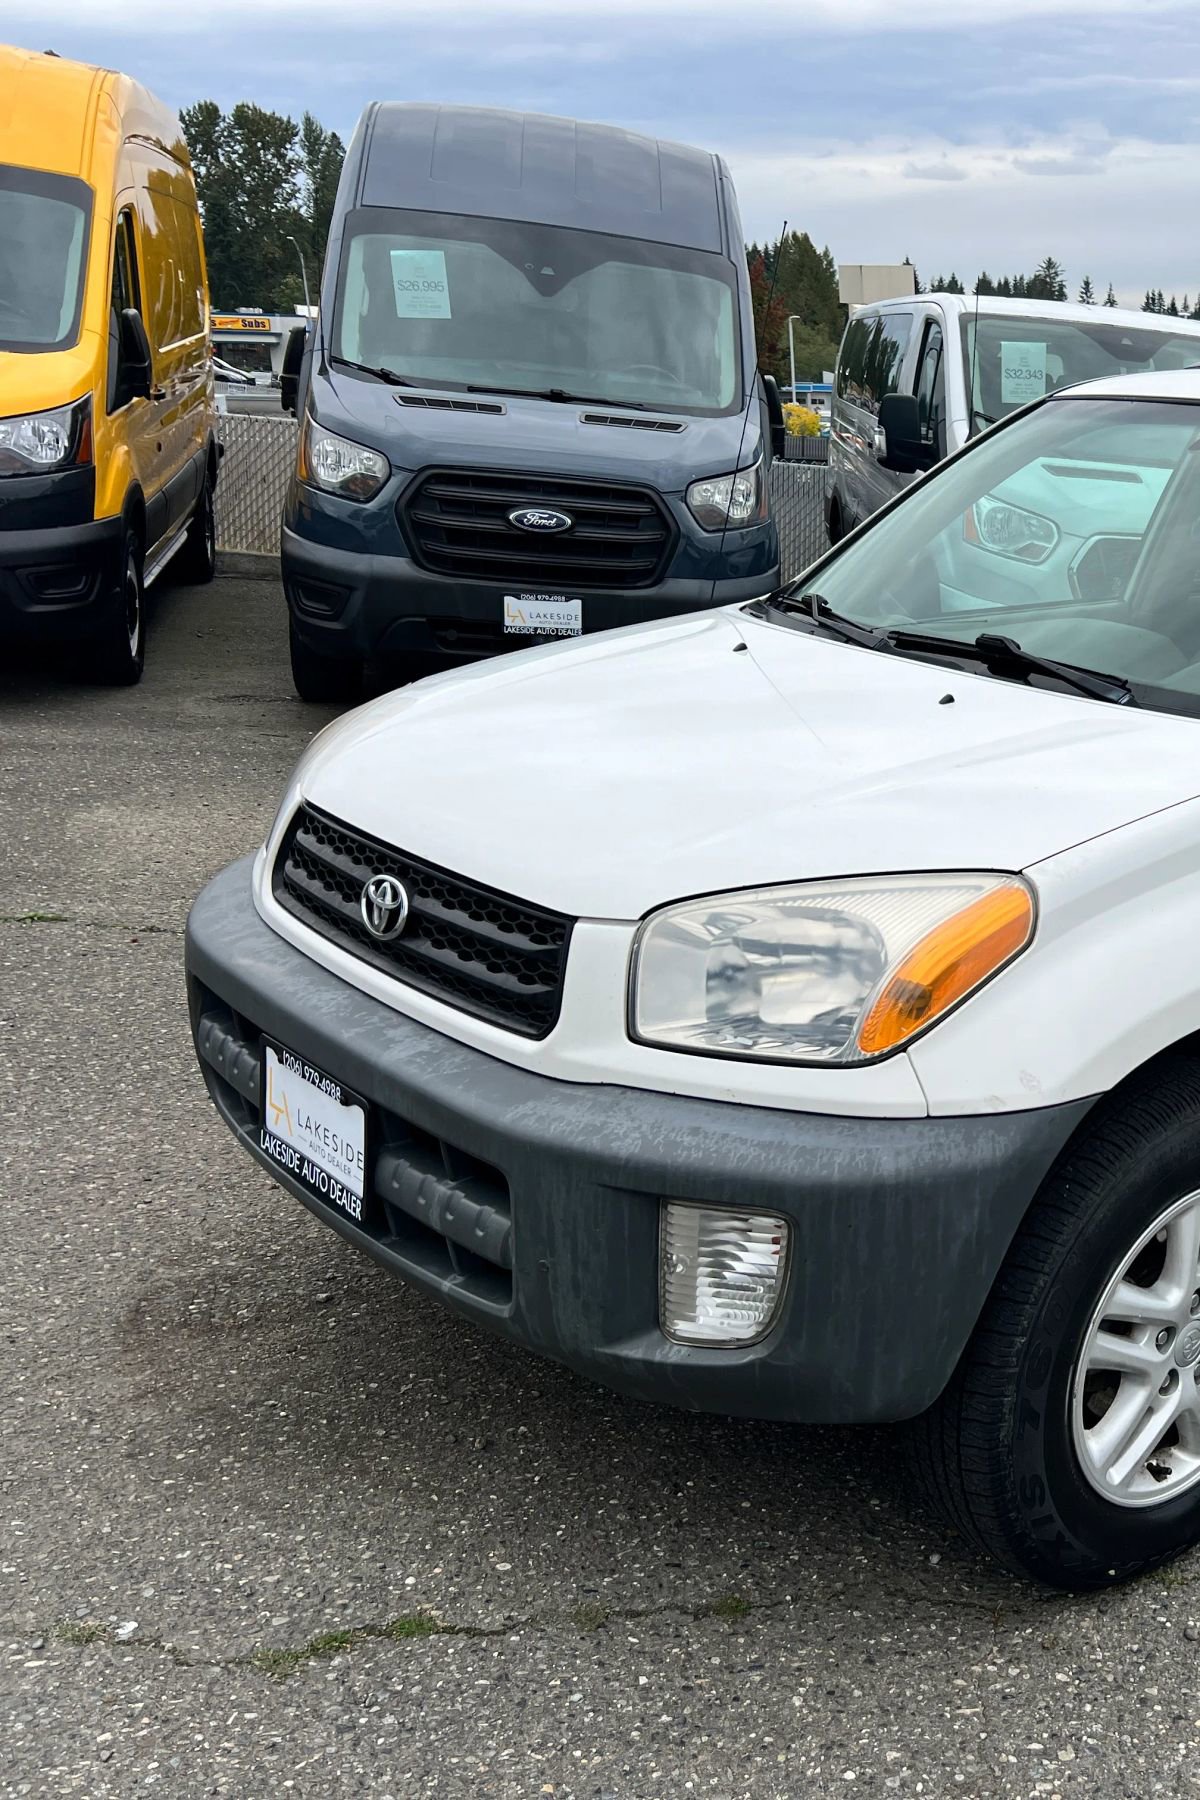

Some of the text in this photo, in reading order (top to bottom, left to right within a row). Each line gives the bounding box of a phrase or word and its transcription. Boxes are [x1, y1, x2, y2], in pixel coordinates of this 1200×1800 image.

[397, 280, 445, 292] $26,995
[241, 319, 266, 328] Subs
[1004, 368, 1044, 380] $32,343
[523, 512, 557, 527] Ford
[529, 612, 580, 621] LAKESIDE
[504, 625, 582, 636] LAKESIDE AUTO DEALER
[282, 1049, 342, 1102] (206) 979-4988
[297, 1107, 364, 1171] LAKESIDE
[308, 1139, 352, 1176] AUTO DEALER
[260, 1129, 362, 1221] LAKESIDE AUTO DEALER
